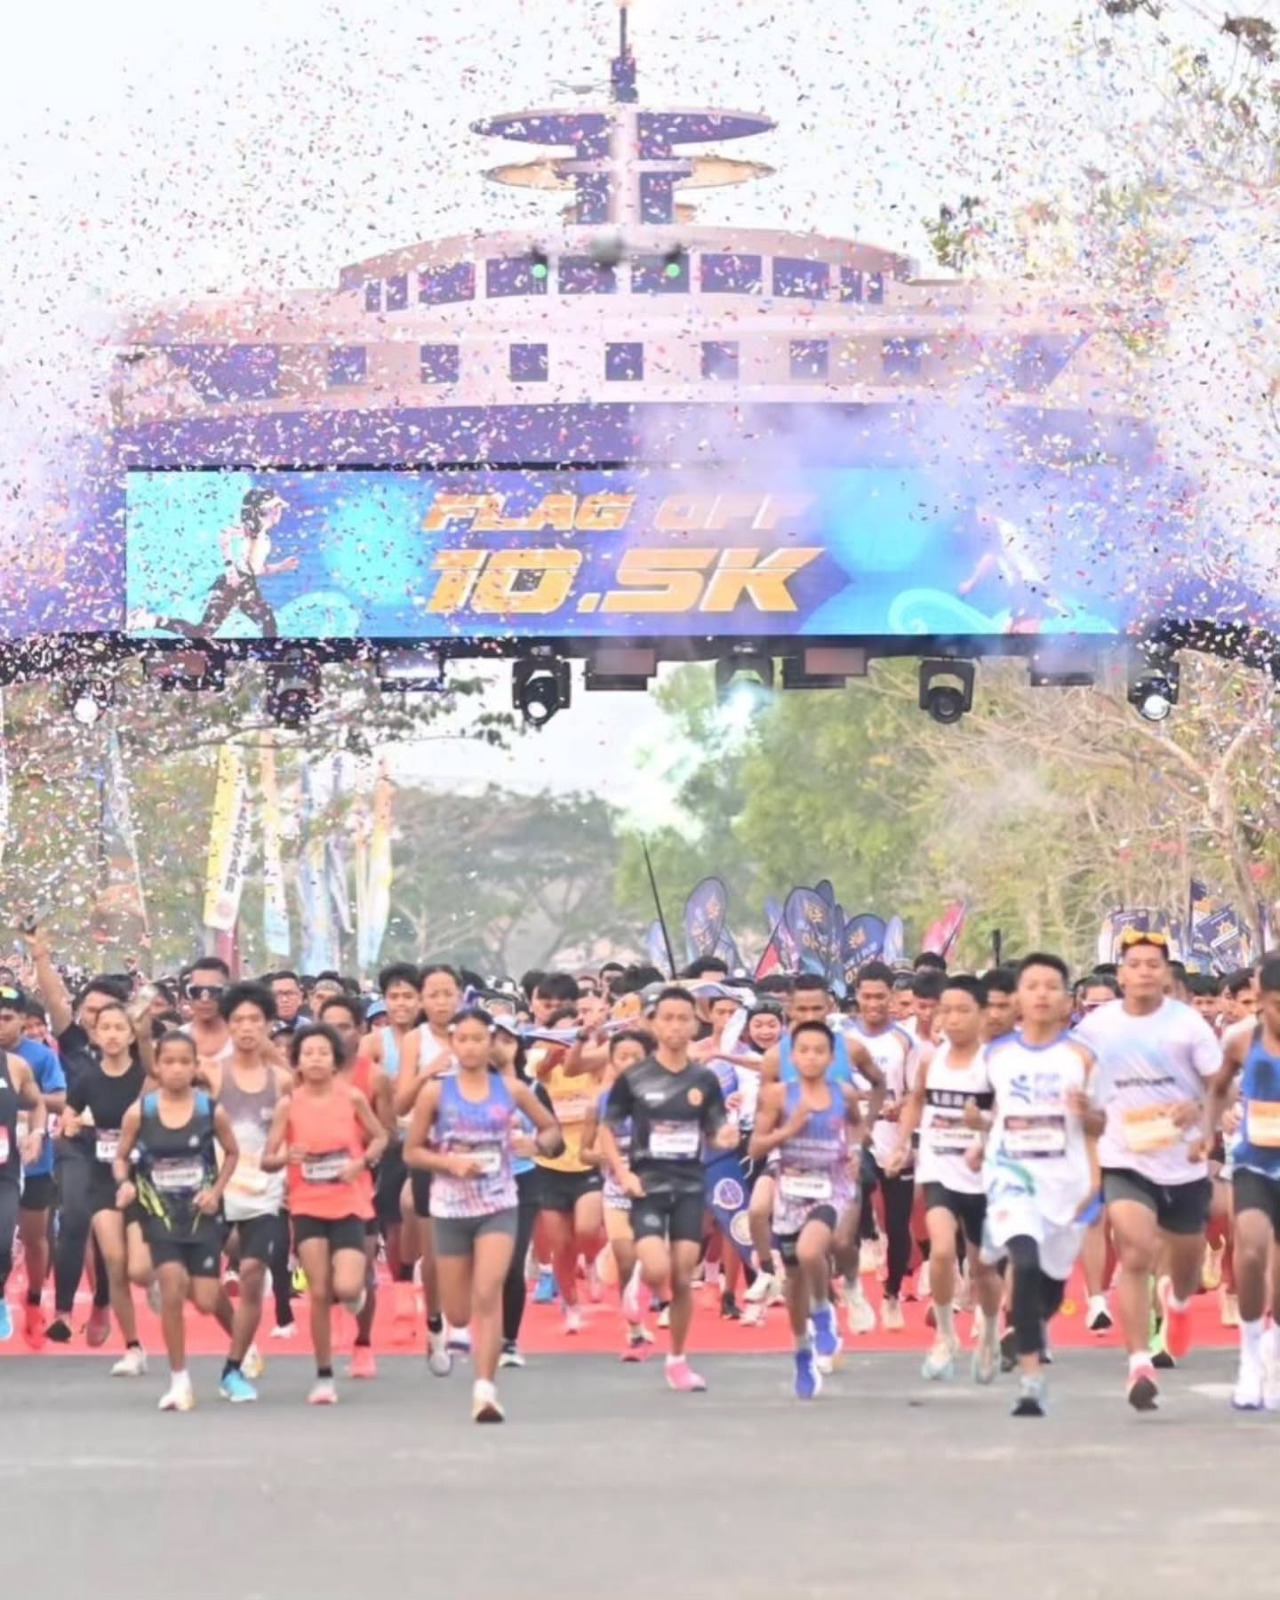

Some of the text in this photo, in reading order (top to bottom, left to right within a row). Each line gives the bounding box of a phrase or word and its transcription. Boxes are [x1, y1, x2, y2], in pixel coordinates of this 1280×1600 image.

[423, 493, 814, 531] FLAG OFF
[427, 548, 825, 613] 10.5K
